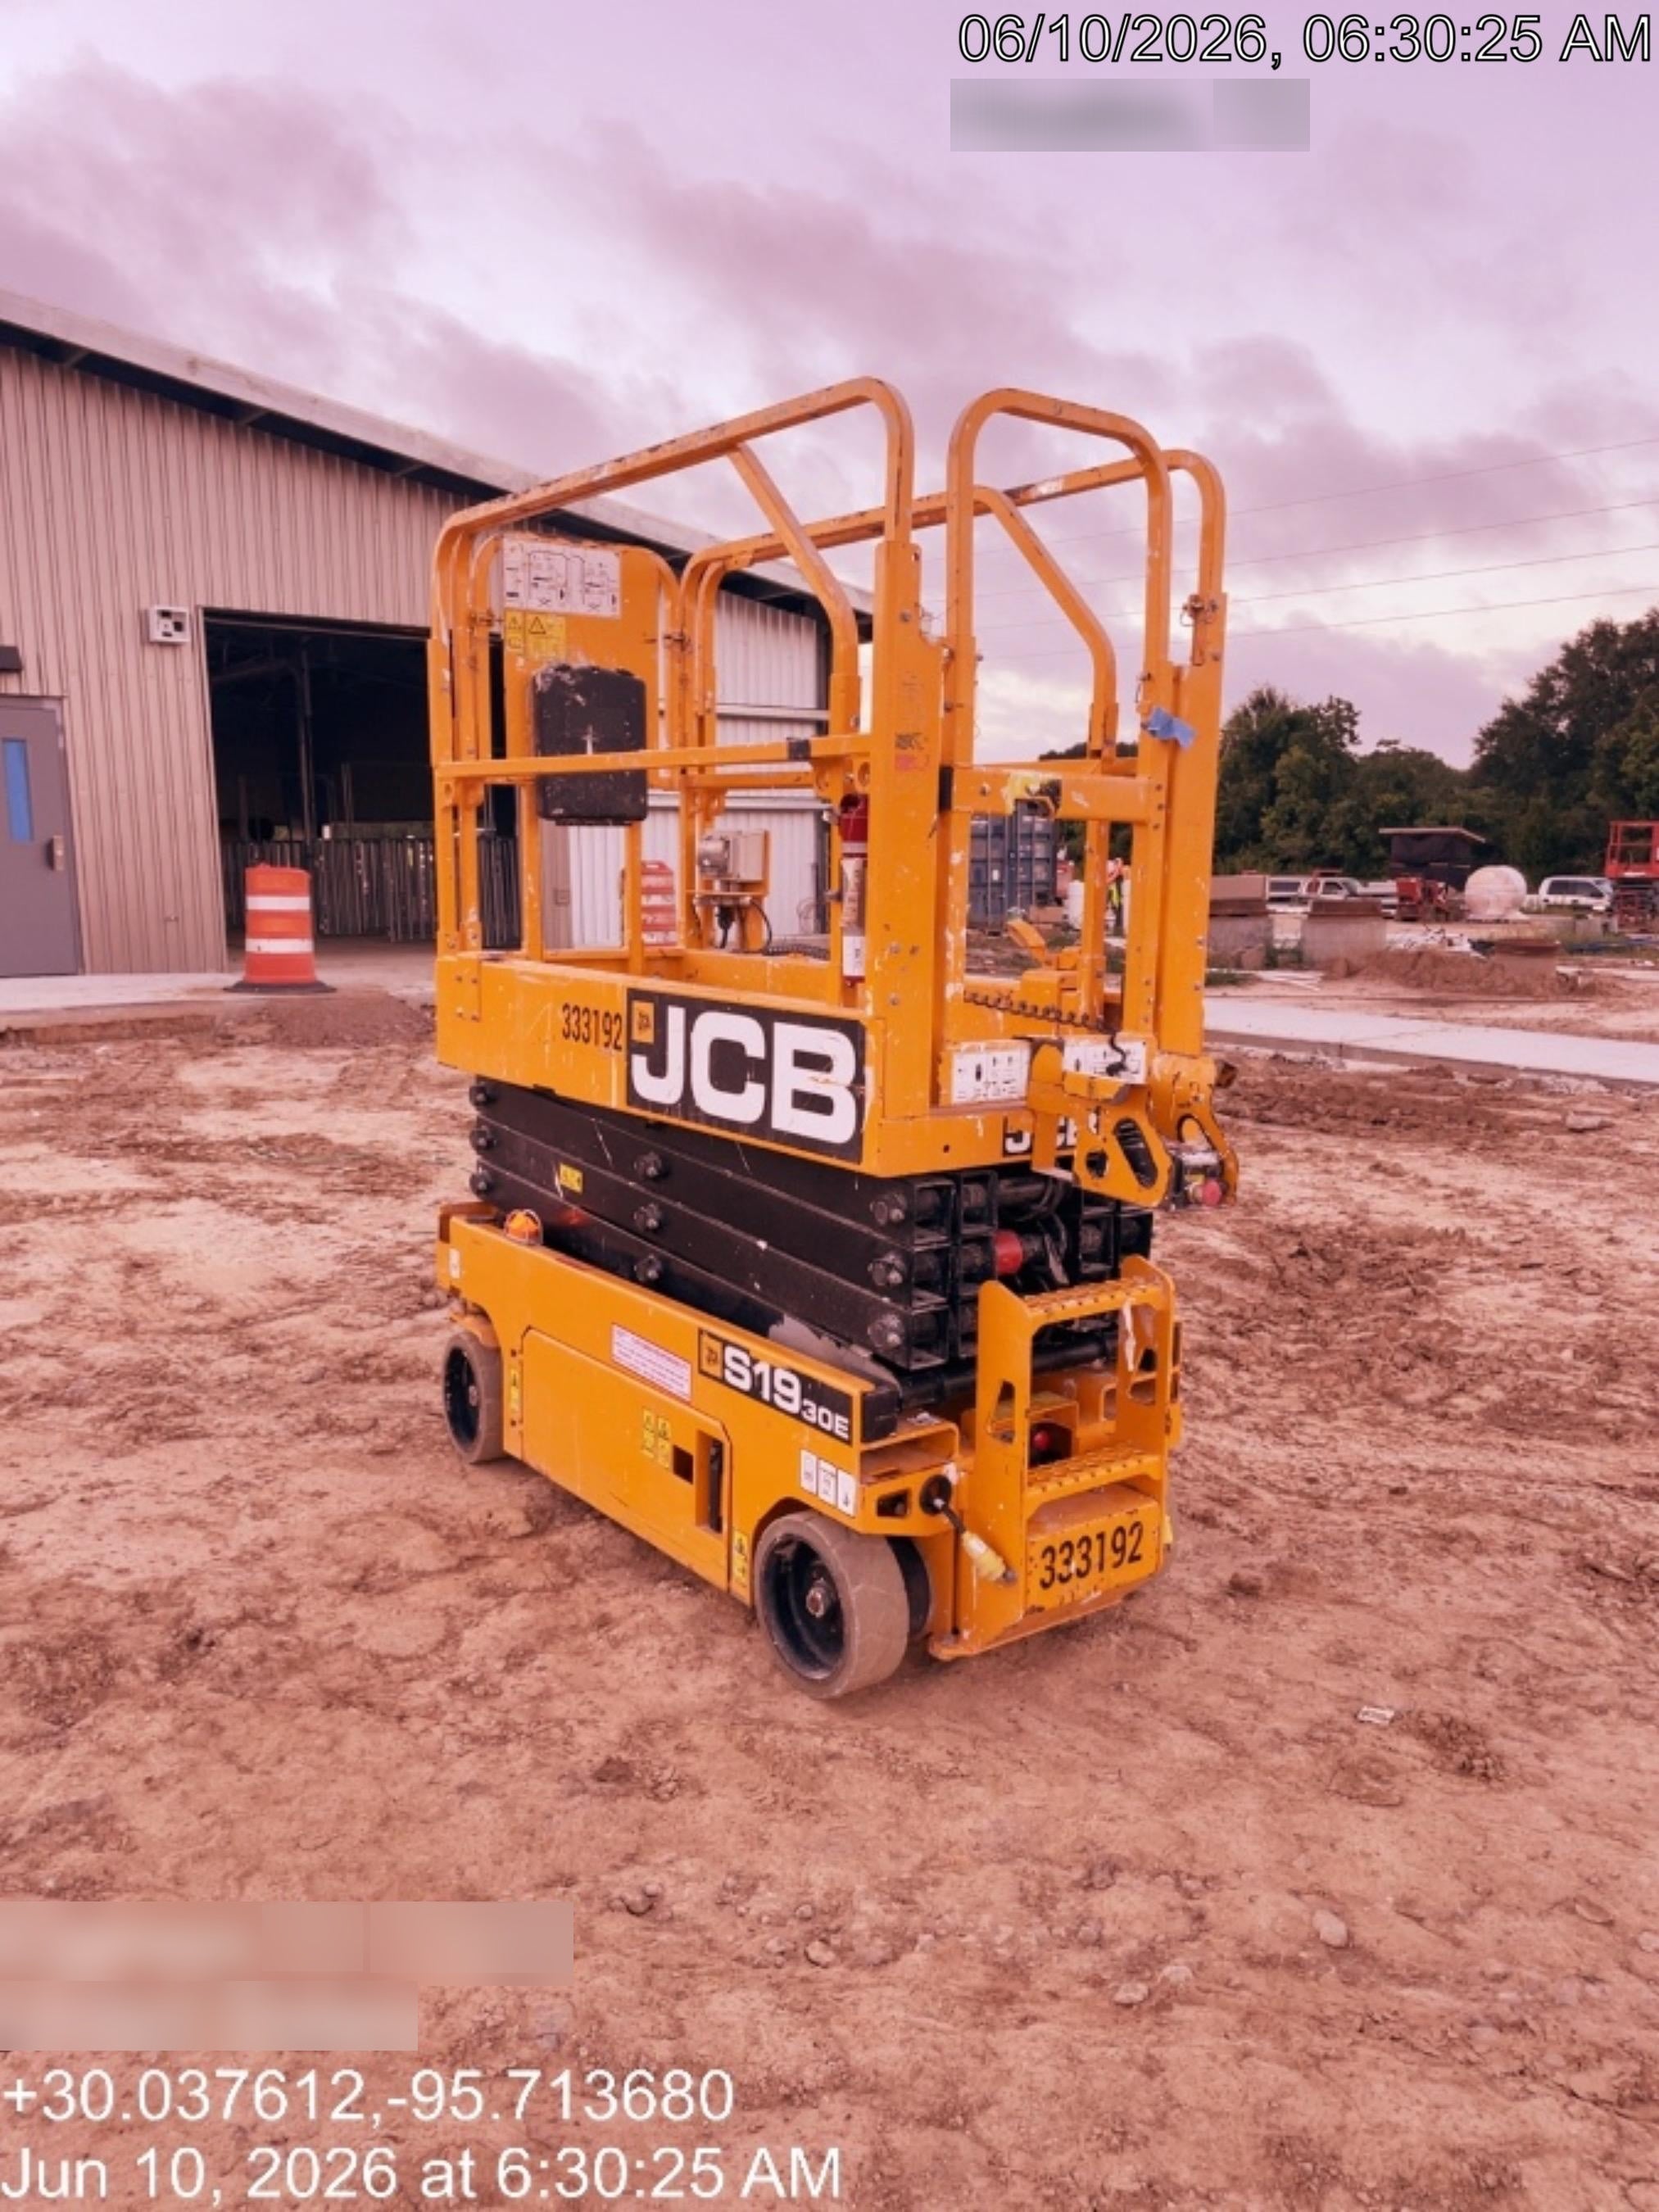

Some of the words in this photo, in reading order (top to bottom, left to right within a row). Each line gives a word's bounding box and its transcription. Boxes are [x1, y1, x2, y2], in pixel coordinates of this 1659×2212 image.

[561, 1002, 623, 1052] 333192
[631, 1004, 857, 1145] JCB
[1039, 1521, 1144, 1590] 333192
